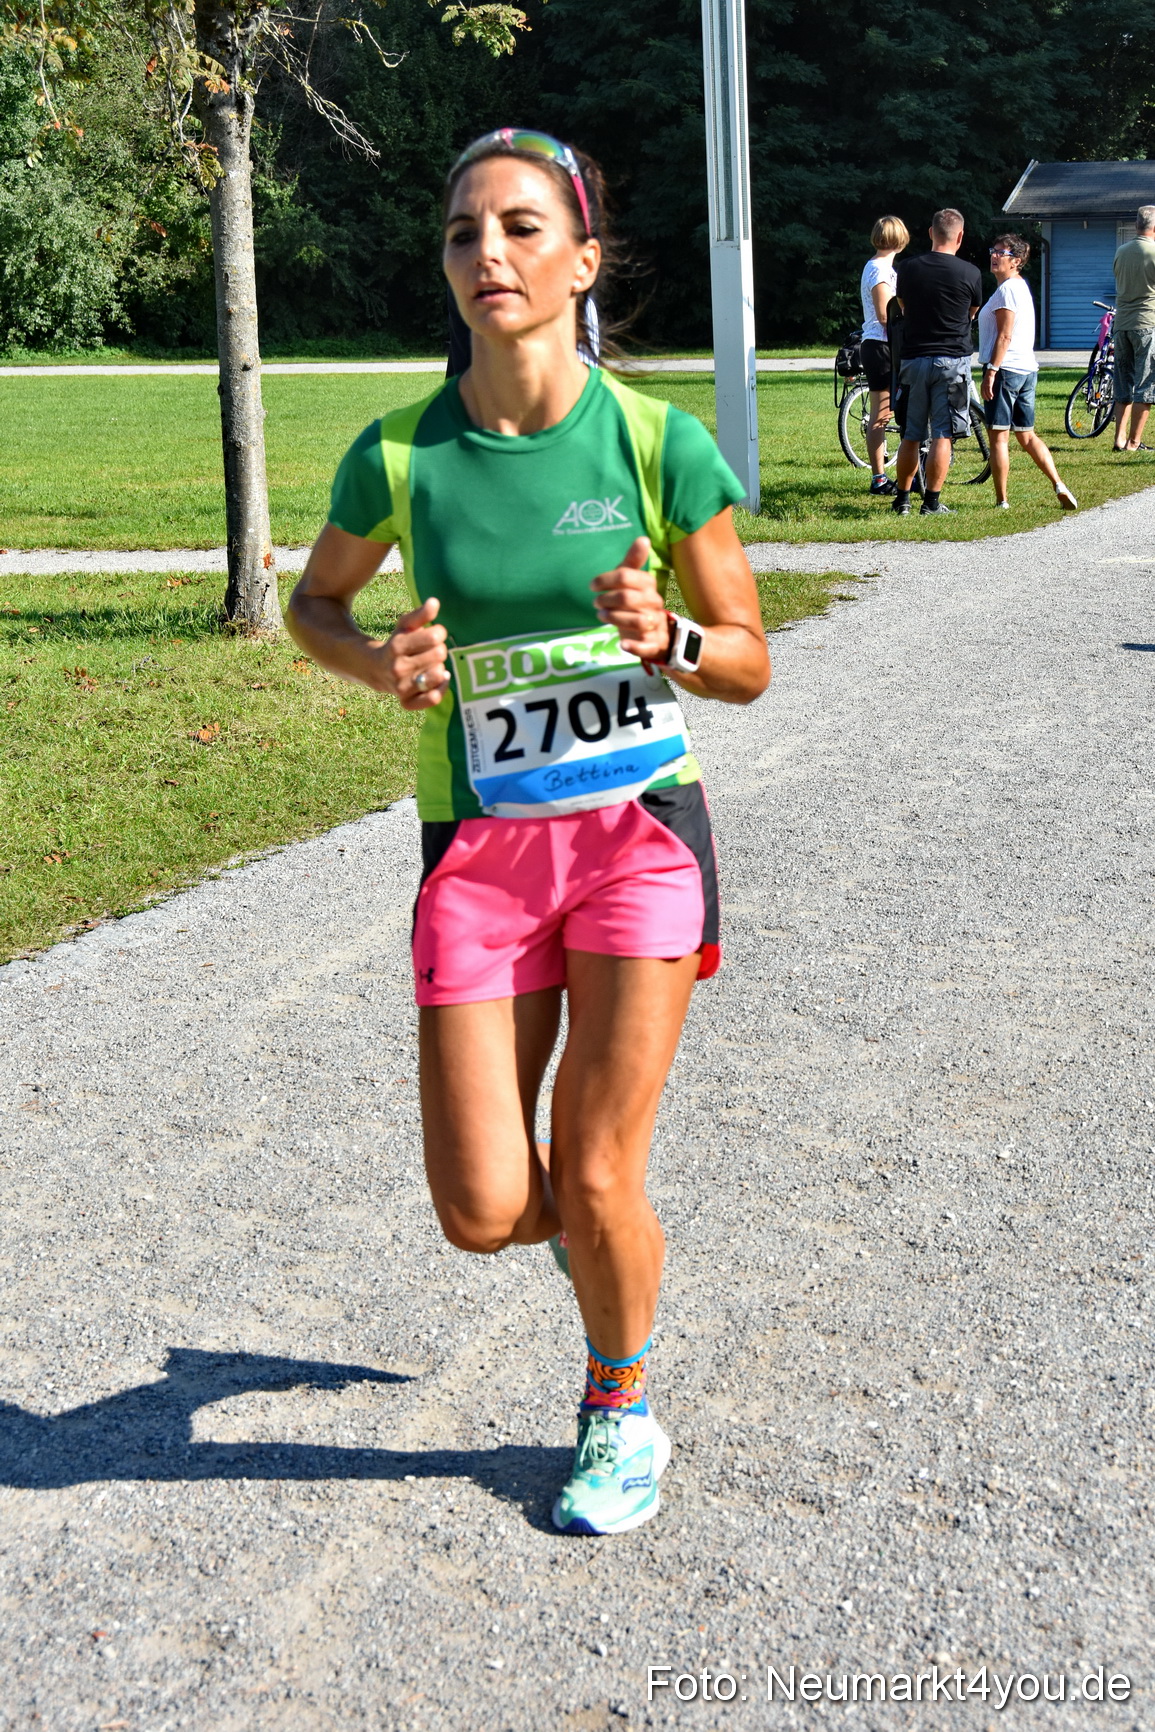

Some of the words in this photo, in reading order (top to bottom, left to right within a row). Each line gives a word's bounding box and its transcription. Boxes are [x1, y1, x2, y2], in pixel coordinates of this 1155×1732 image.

[554, 494, 629, 529] AOK
[485, 680, 654, 763] 2704
[543, 761, 640, 792] Bettina
